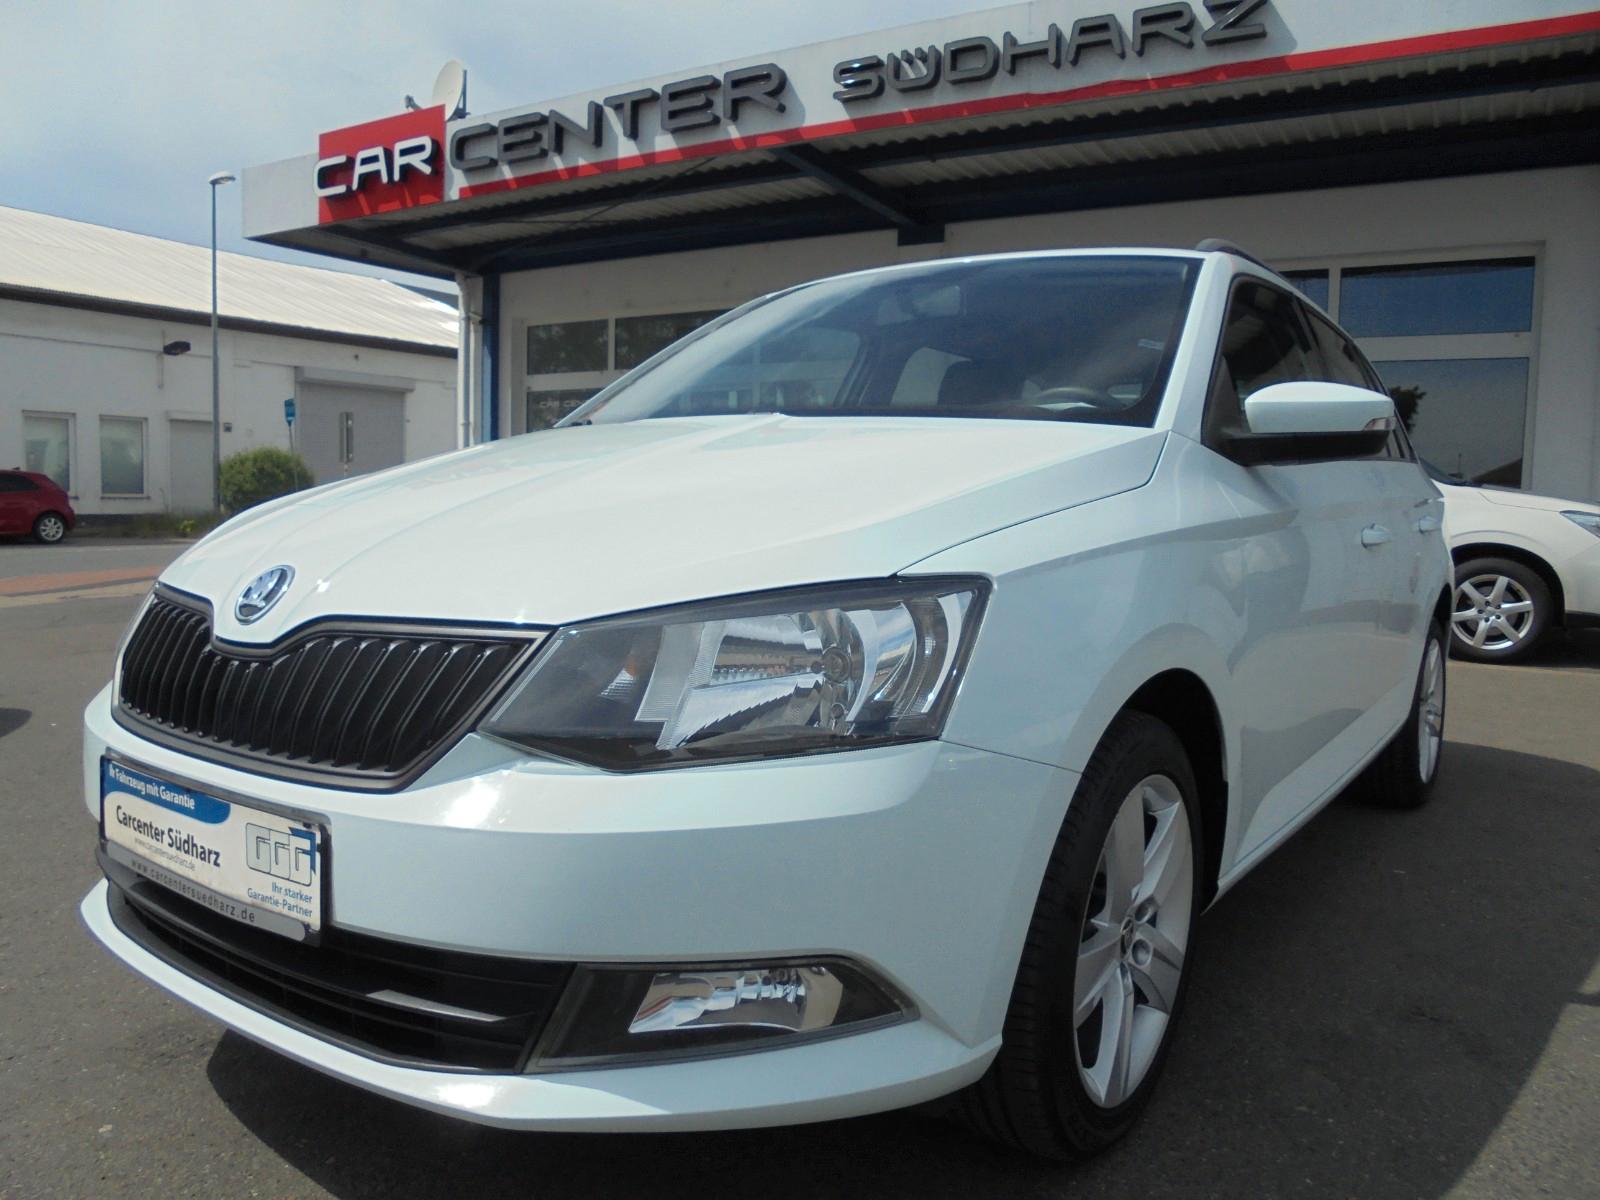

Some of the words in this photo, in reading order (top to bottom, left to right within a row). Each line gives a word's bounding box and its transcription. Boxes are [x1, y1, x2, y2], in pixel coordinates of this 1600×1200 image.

[313, 135, 440, 198] CAR
[450, 63, 788, 171] CENTER
[833, 0, 1267, 101] SÜDHARZ
[116, 768, 146, 795] Fahrzeug
[146, 782, 160, 797] mit
[160, 785, 195, 810] Garantie
[116, 804, 165, 844] Carcenter
[167, 827, 221, 867] Südharz
[247, 886, 313, 918] Garantie-Partner
[271, 881, 283, 894] Ihr
[284, 887, 313, 904] starker
